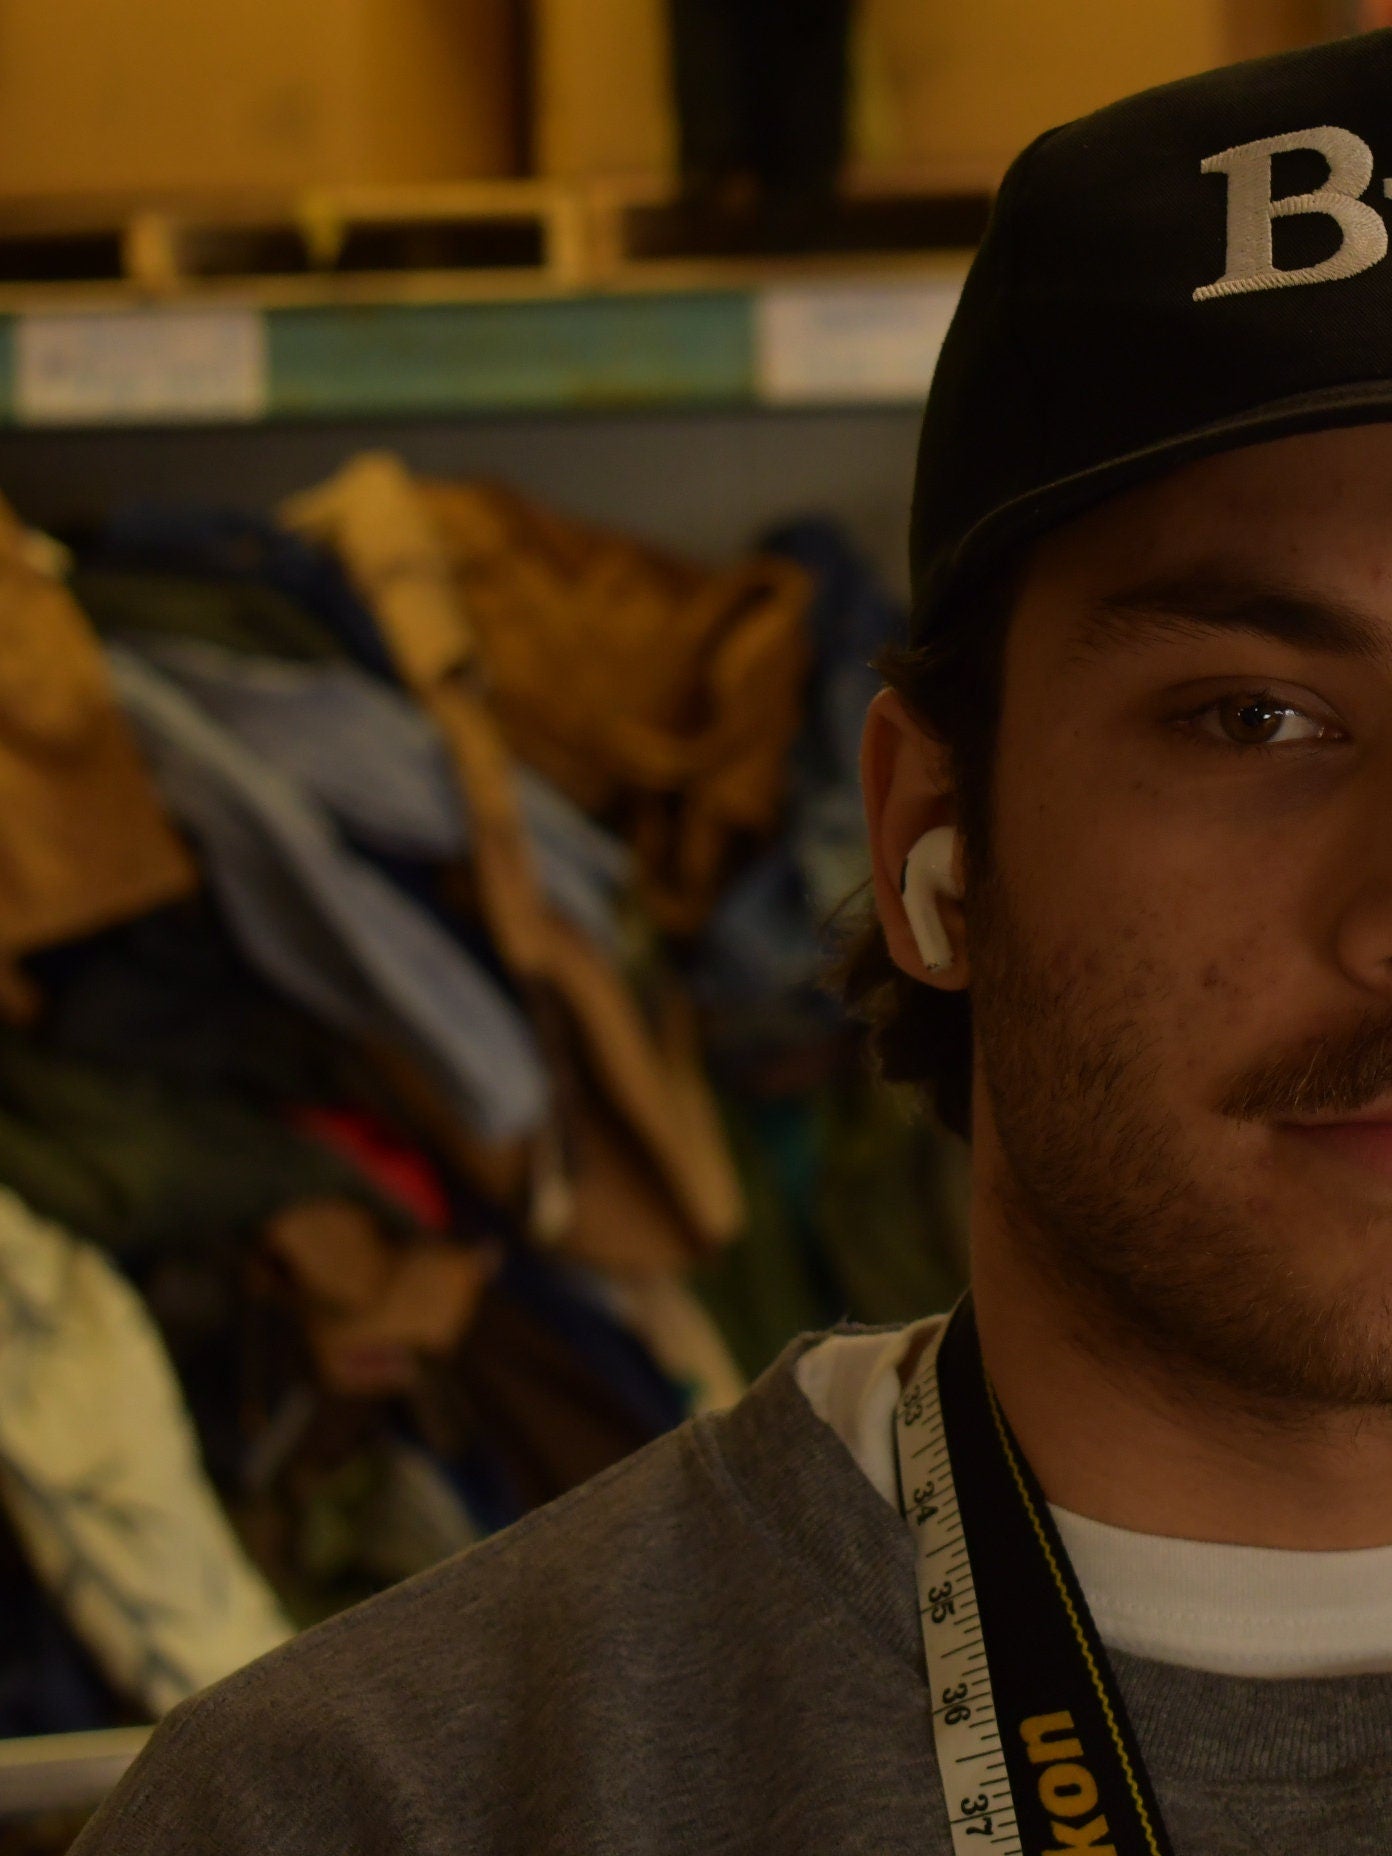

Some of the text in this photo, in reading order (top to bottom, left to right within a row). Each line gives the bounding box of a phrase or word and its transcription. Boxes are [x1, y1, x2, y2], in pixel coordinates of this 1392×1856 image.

[913, 1480, 939, 1526] 34
[928, 1581, 956, 1624] 35
[942, 1683, 971, 1725] 36
[960, 1794, 994, 1836] 37
